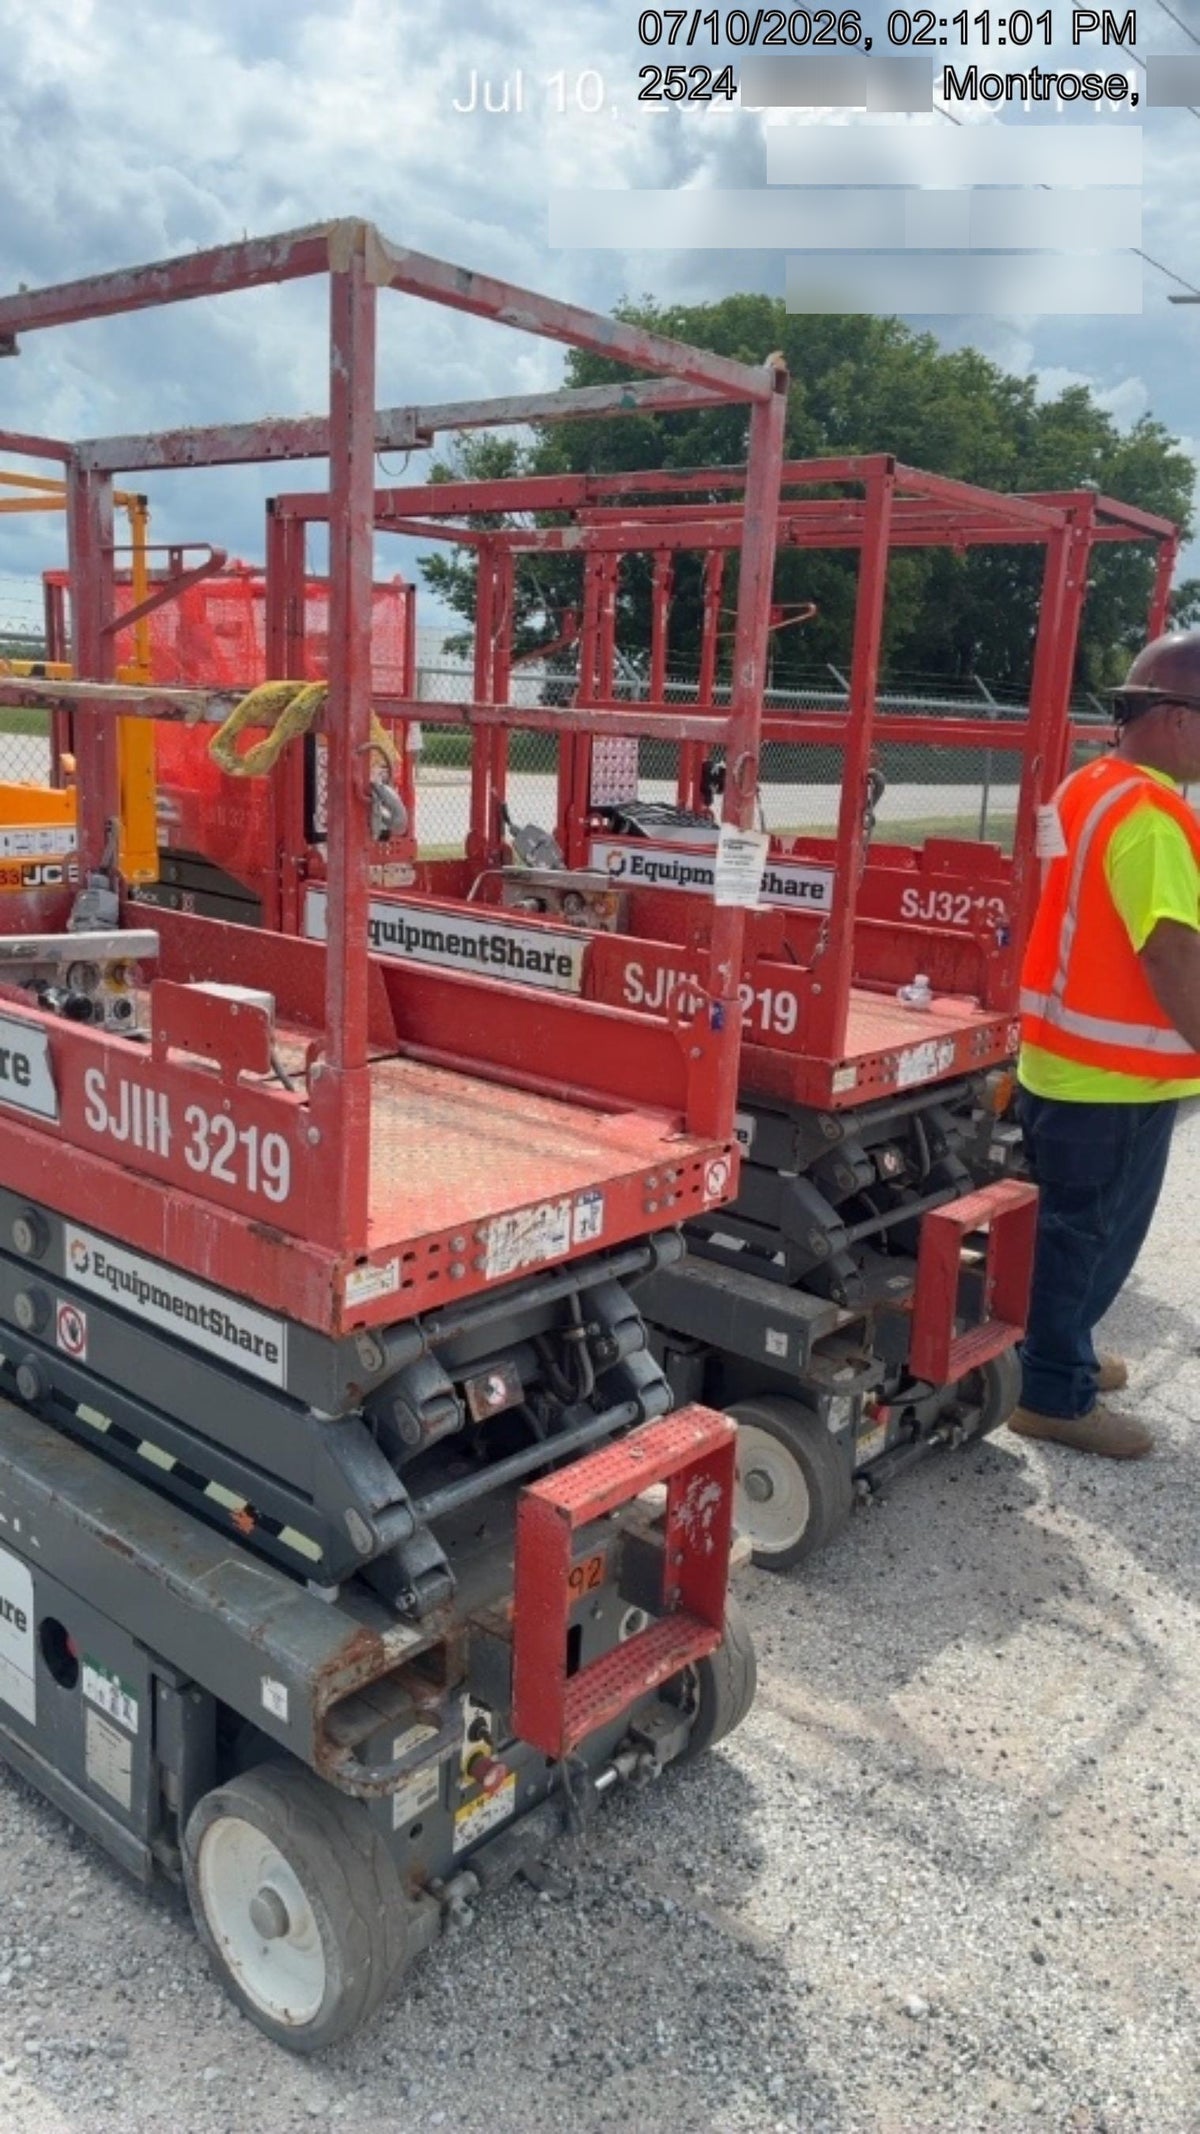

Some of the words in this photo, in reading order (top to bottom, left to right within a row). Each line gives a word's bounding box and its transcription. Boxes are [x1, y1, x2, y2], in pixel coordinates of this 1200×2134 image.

[630, 856, 824, 899] Equipmhare
[368, 917, 573, 977] quipmentShare
[737, 983, 798, 1035] 219
[184, 1104, 290, 1203] 3219
[92, 1251, 278, 1364] EquipmentShare
